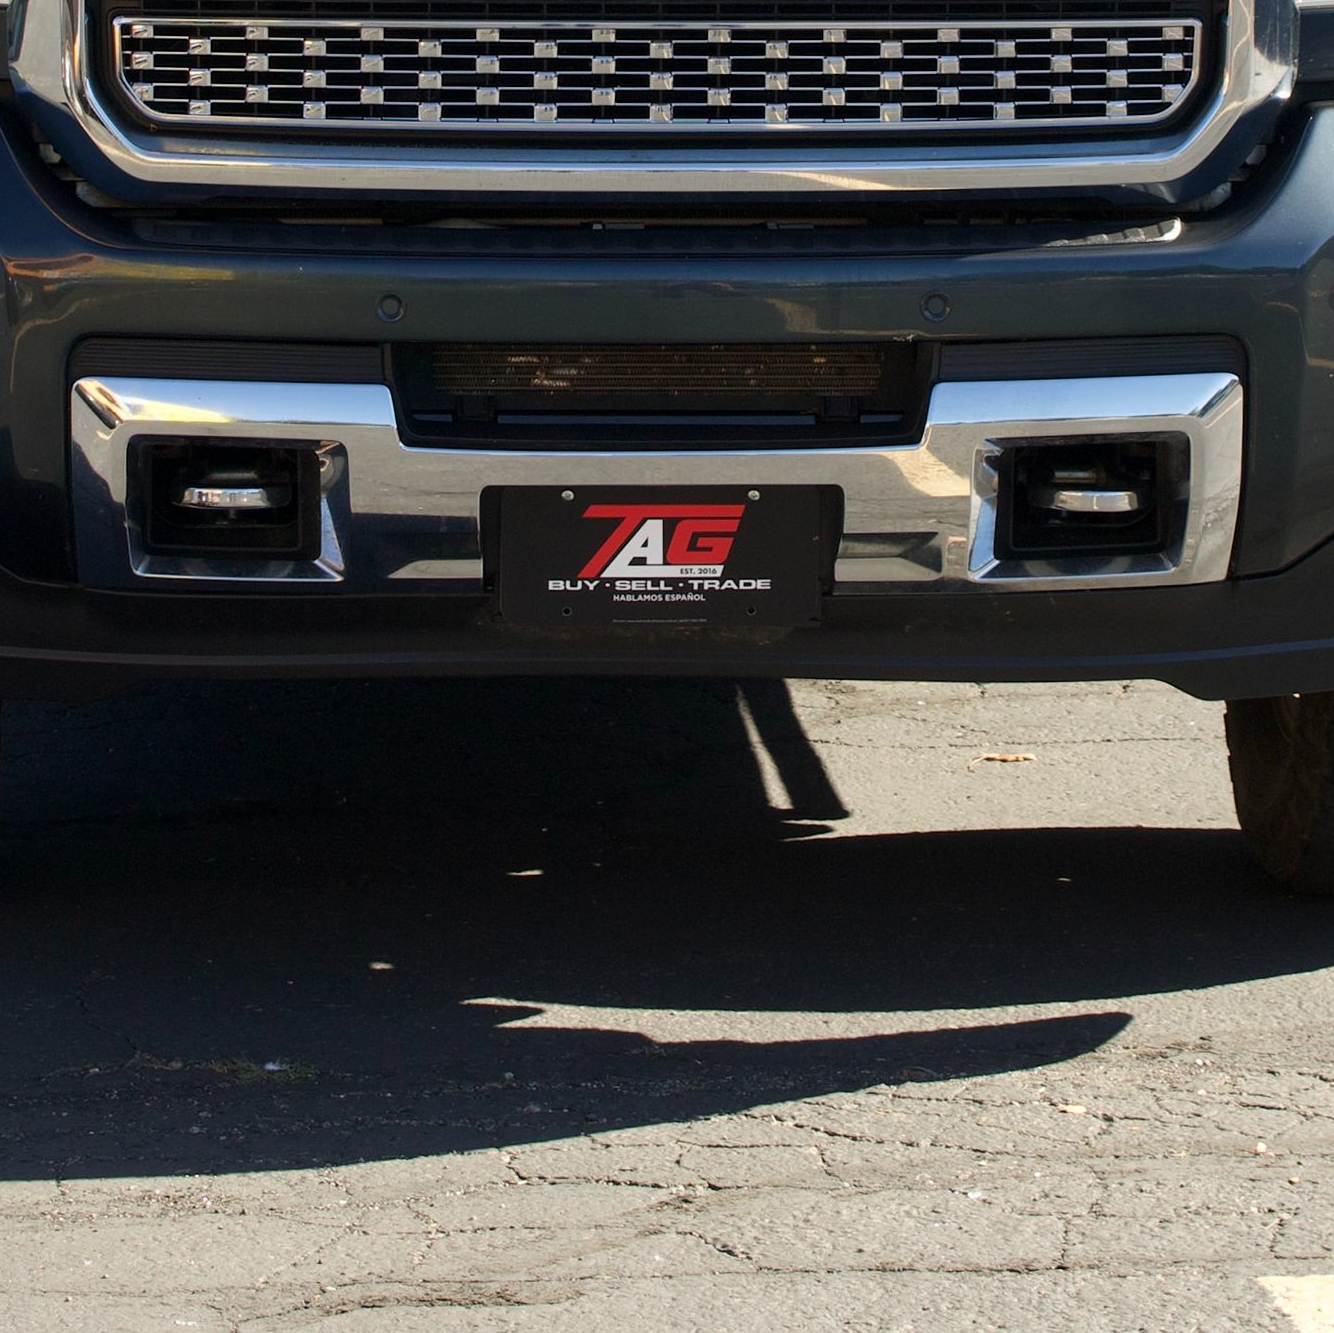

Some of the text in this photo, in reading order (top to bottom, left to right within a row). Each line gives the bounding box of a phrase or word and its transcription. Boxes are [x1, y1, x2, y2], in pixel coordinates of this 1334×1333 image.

[577, 504, 746, 578] TAG
[679, 567, 718, 575] EST. 2016
[548, 578, 772, 591] BUY SELL TRADE
[612, 592, 706, 602] HABLAMOS ESPAÑOL
